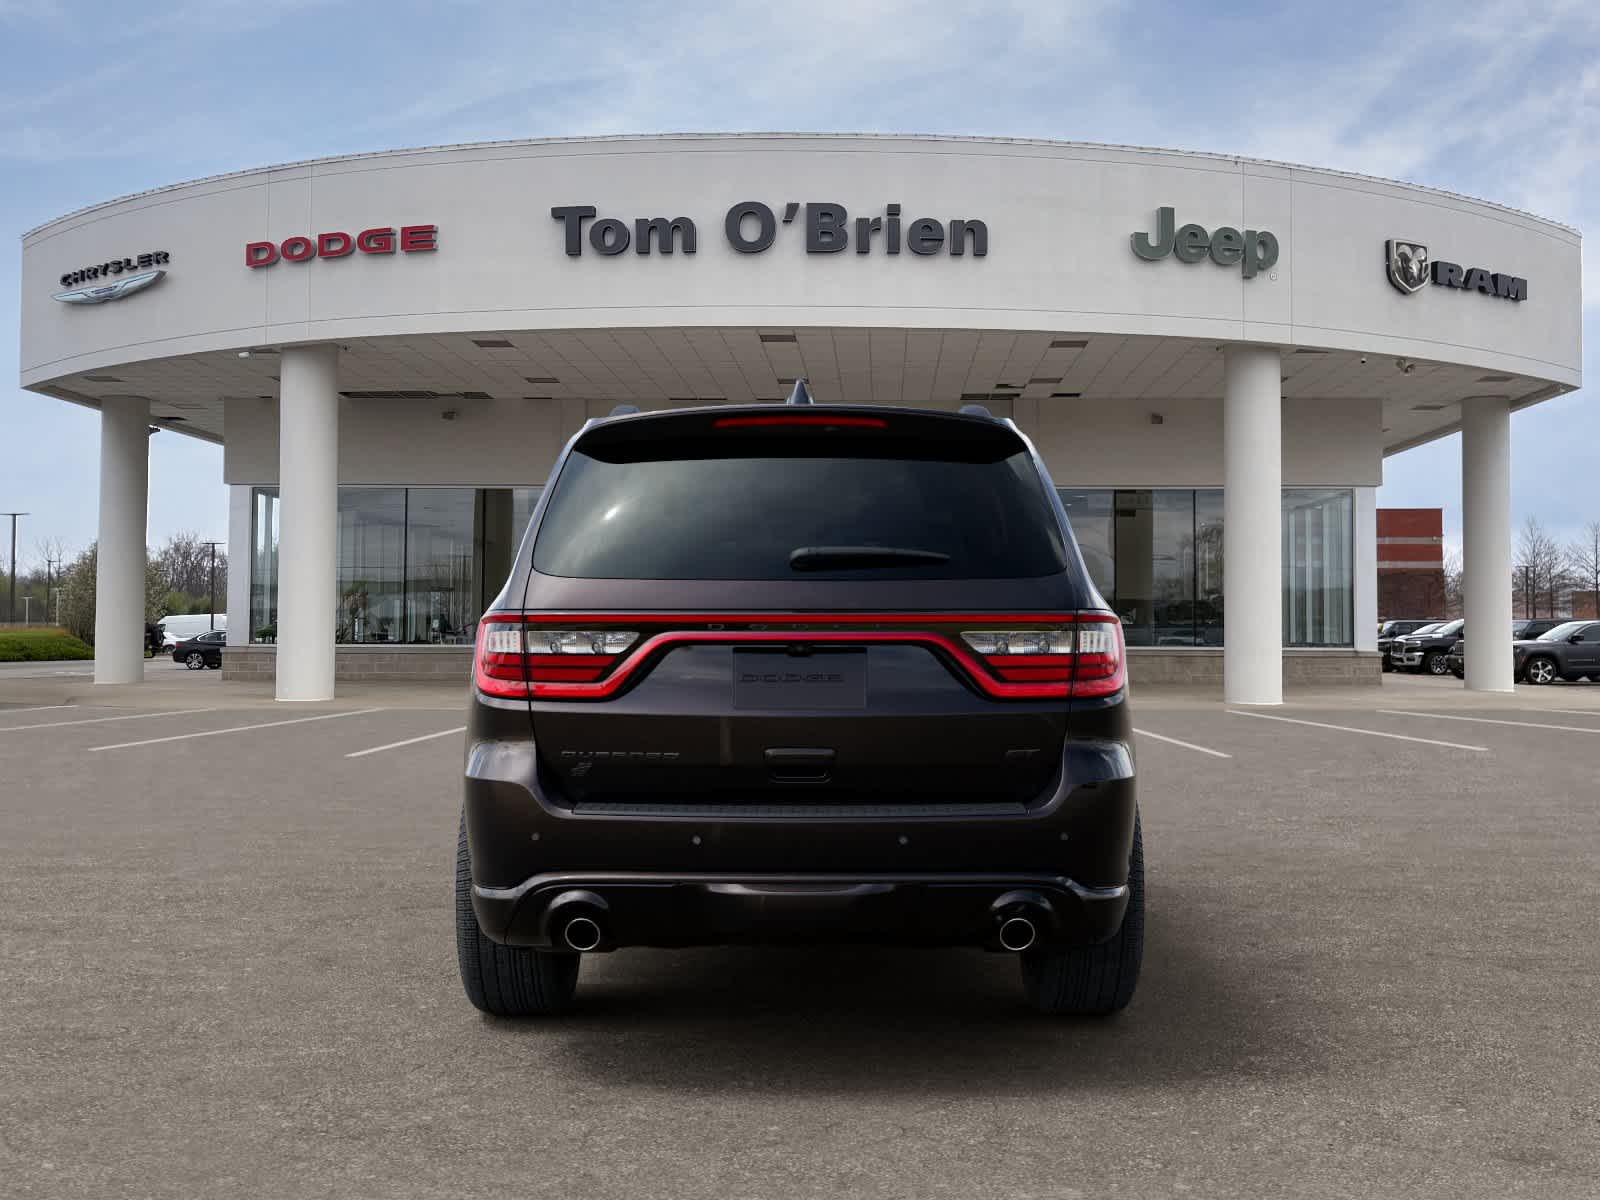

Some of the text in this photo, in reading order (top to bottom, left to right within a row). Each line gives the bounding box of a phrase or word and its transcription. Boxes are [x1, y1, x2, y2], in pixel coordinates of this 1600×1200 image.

[246, 224, 440, 269] DODGE
[551, 200, 989, 257] Tom O'Brien
[1130, 206, 1280, 280] Jeep
[60, 250, 170, 287] CHRYSLER
[1431, 260, 1528, 302] RAM
